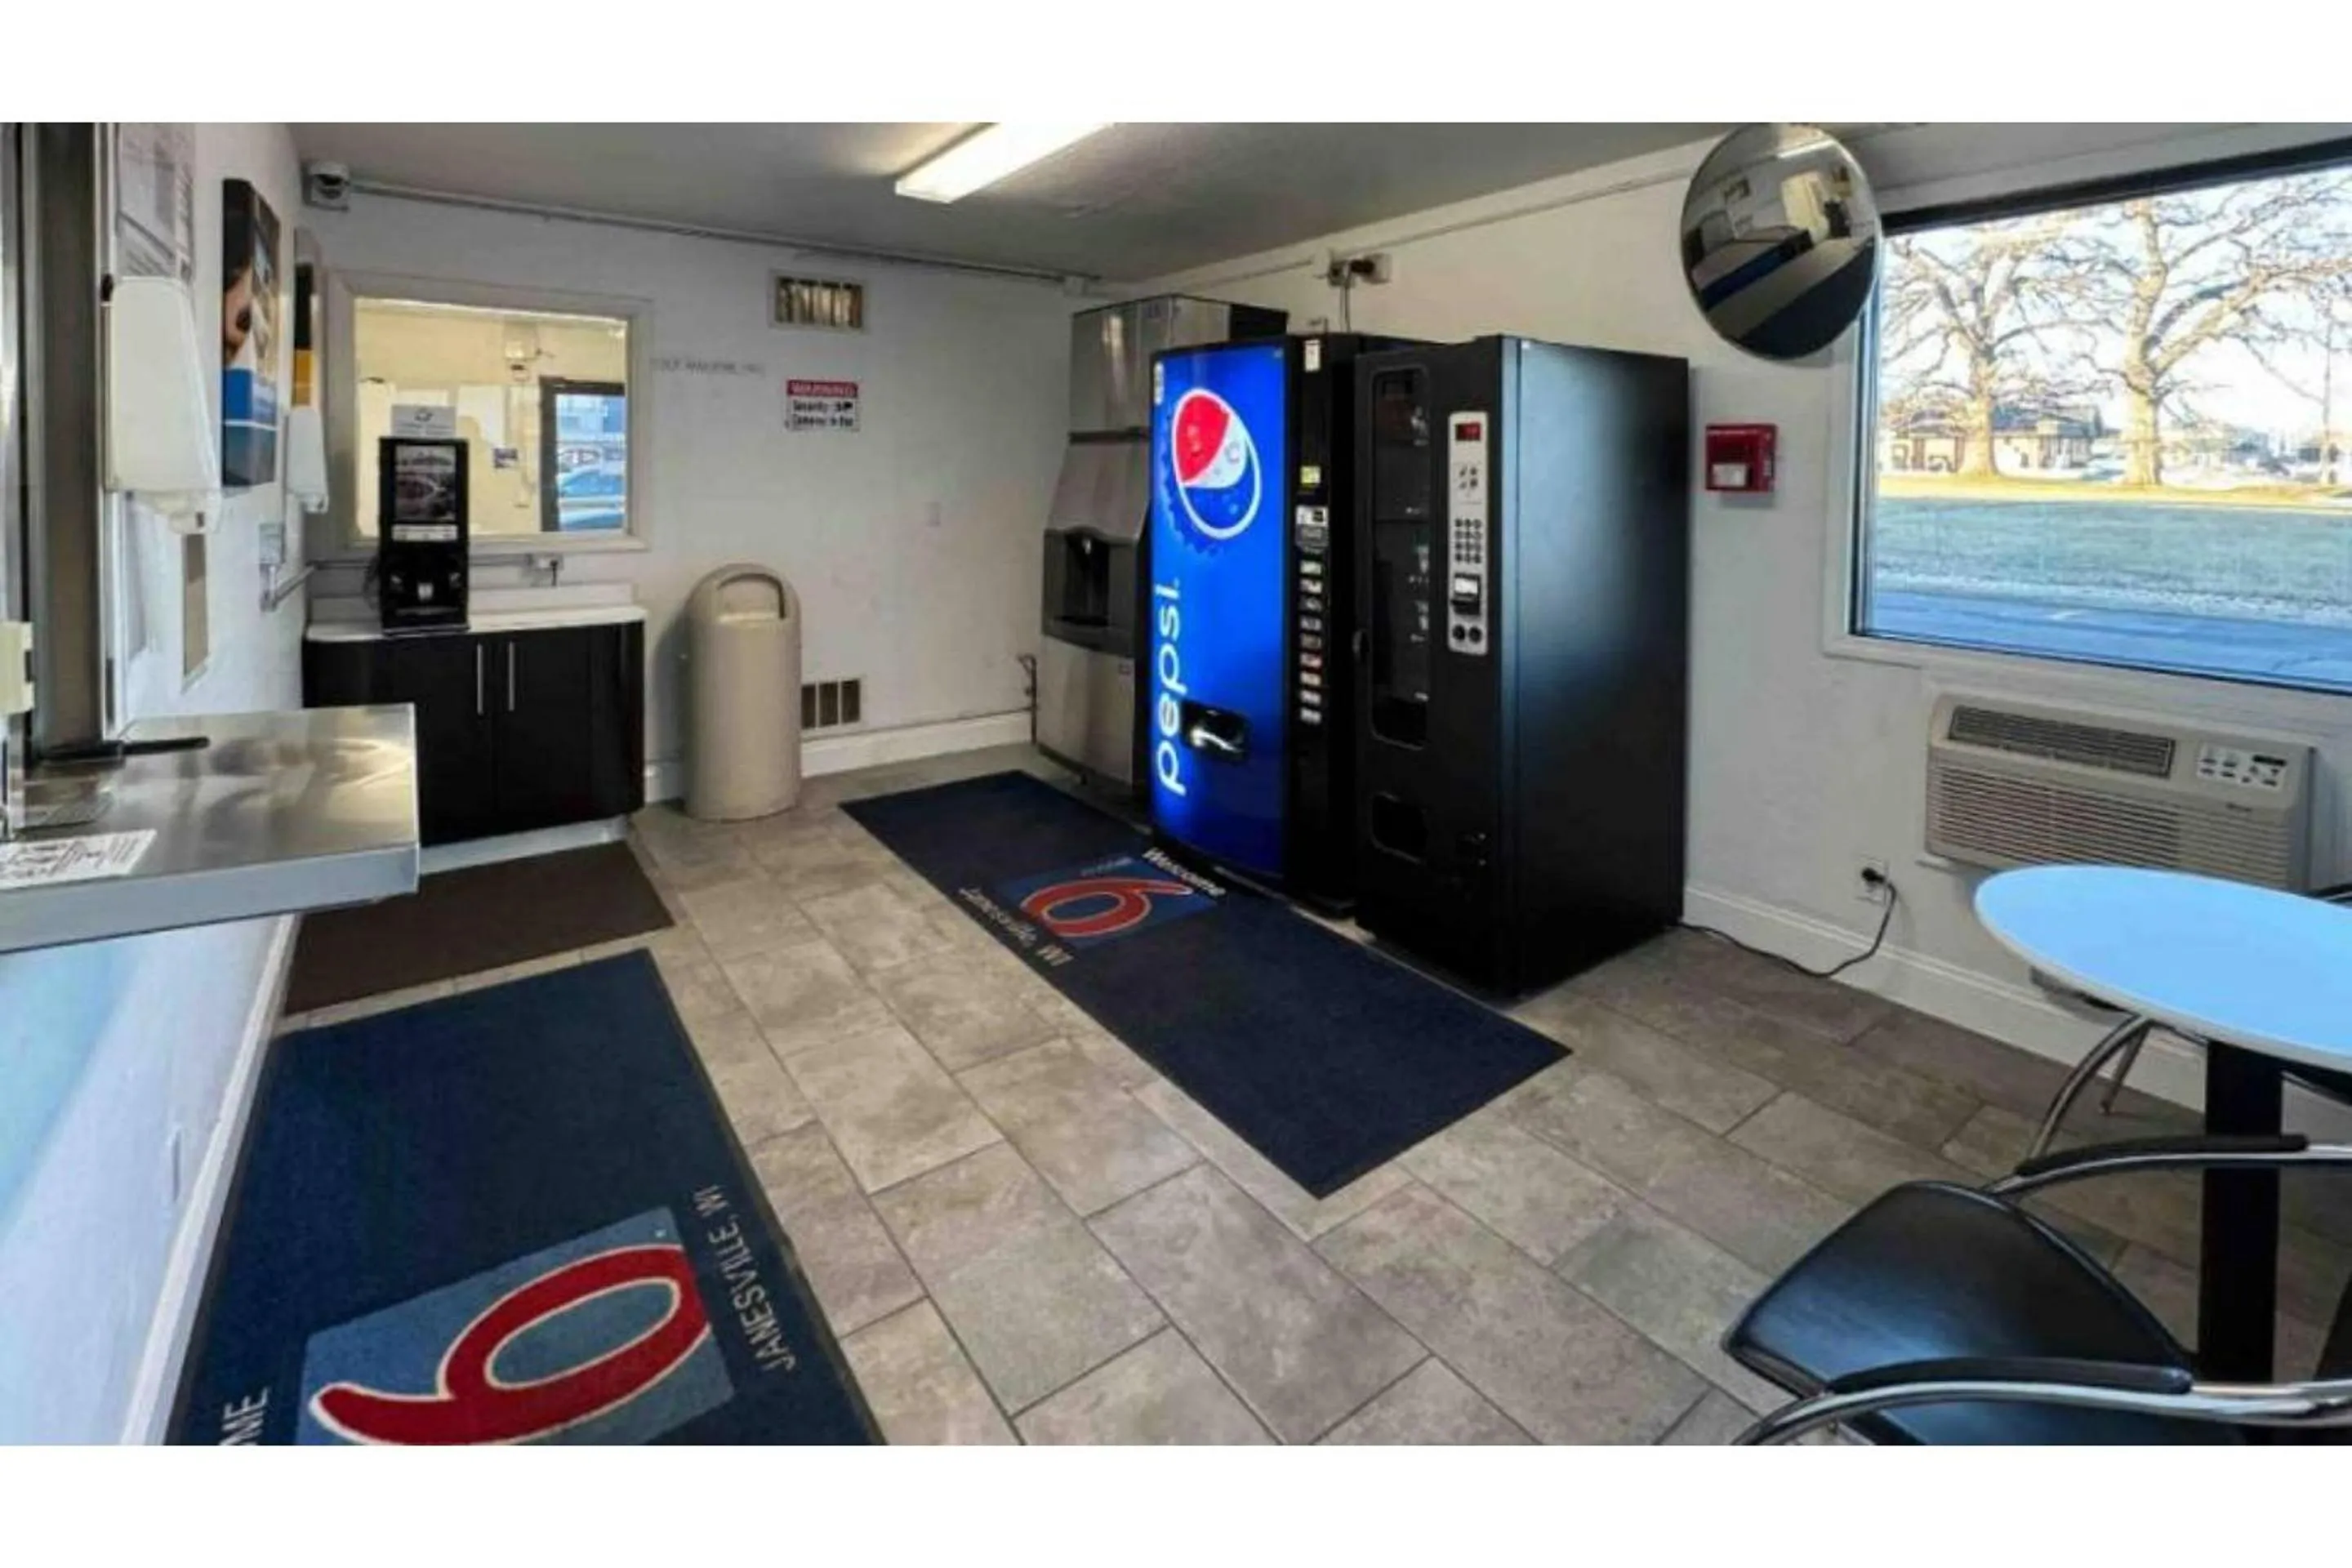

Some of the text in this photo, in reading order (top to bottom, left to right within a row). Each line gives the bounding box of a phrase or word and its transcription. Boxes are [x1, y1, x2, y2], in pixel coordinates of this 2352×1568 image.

[1154, 579, 1188, 796] pepsi
[1021, 877, 1193, 938] 6
[693, 1184, 730, 1217] WI
[309, 1244, 710, 1445] 6
